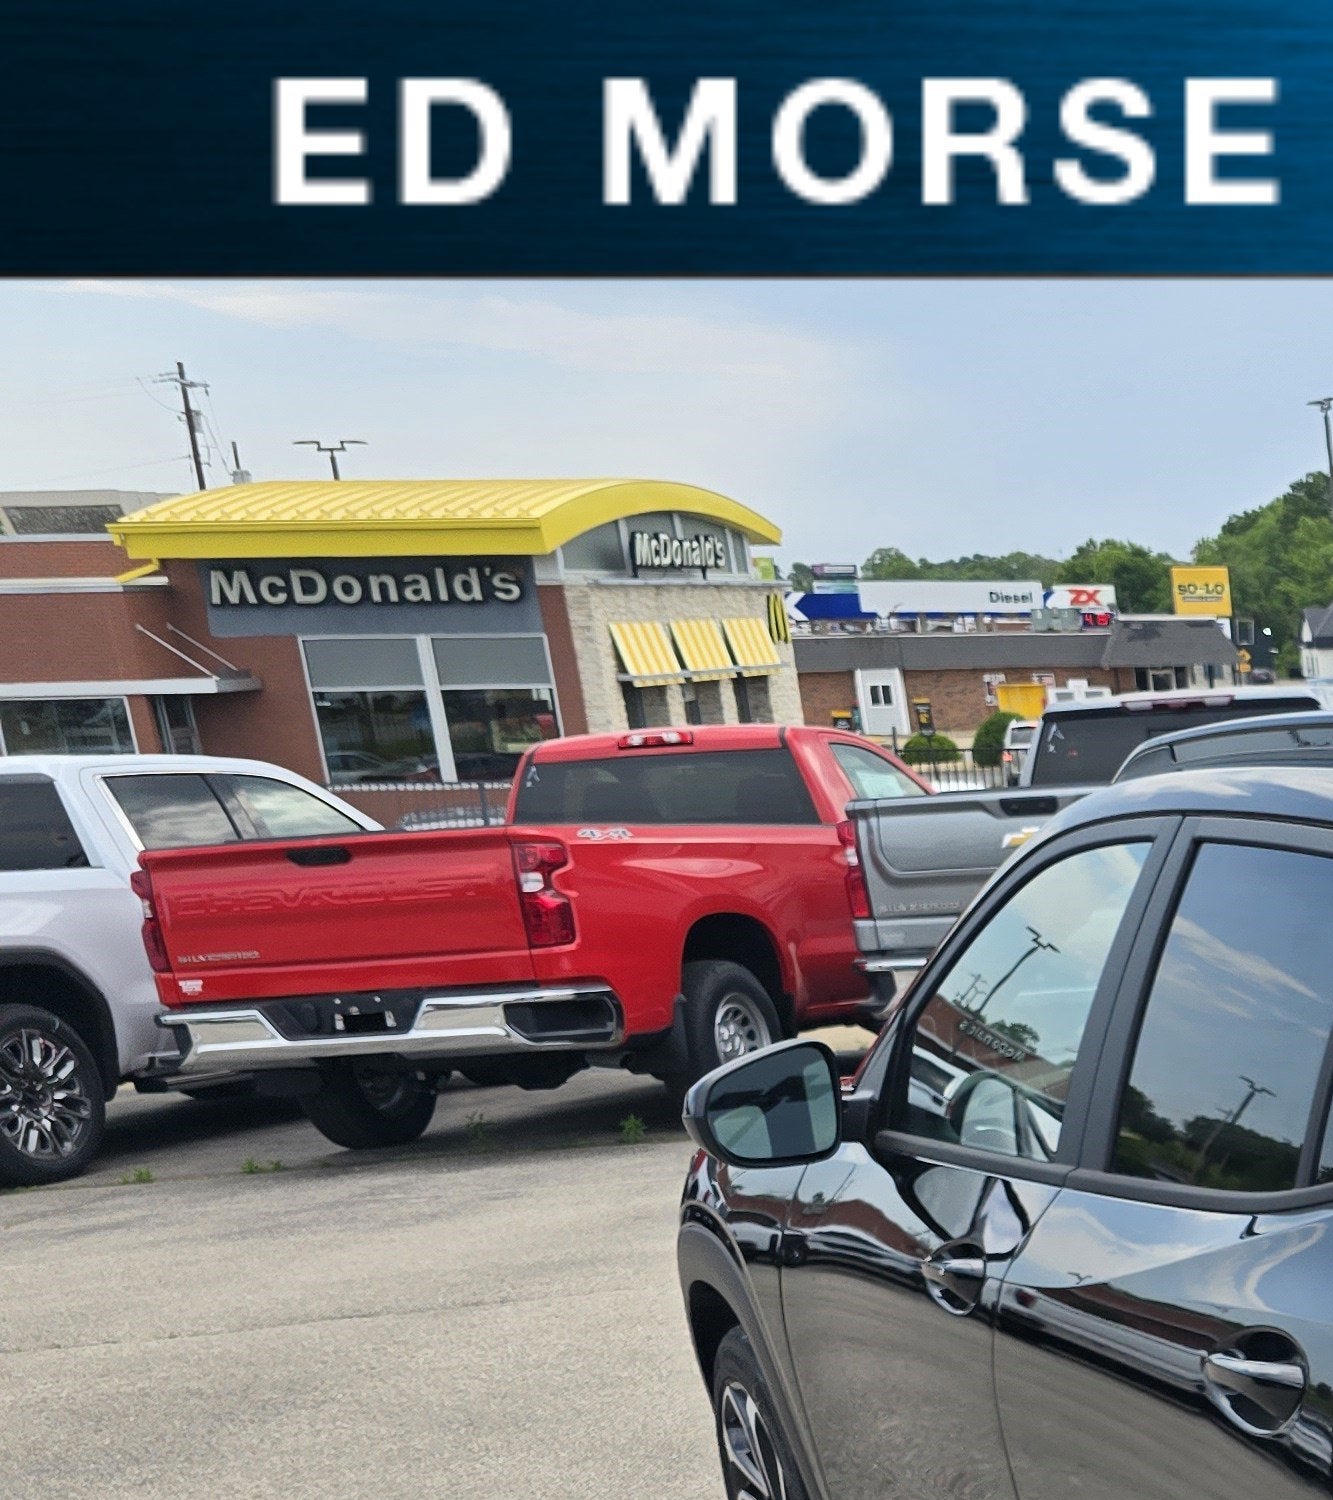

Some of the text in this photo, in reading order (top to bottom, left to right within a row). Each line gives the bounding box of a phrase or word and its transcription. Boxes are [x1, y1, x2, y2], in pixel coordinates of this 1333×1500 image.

[632, 531, 727, 568] McDonald's
[209, 567, 522, 605] McDonald's
[988, 590, 1034, 604] Diesel
